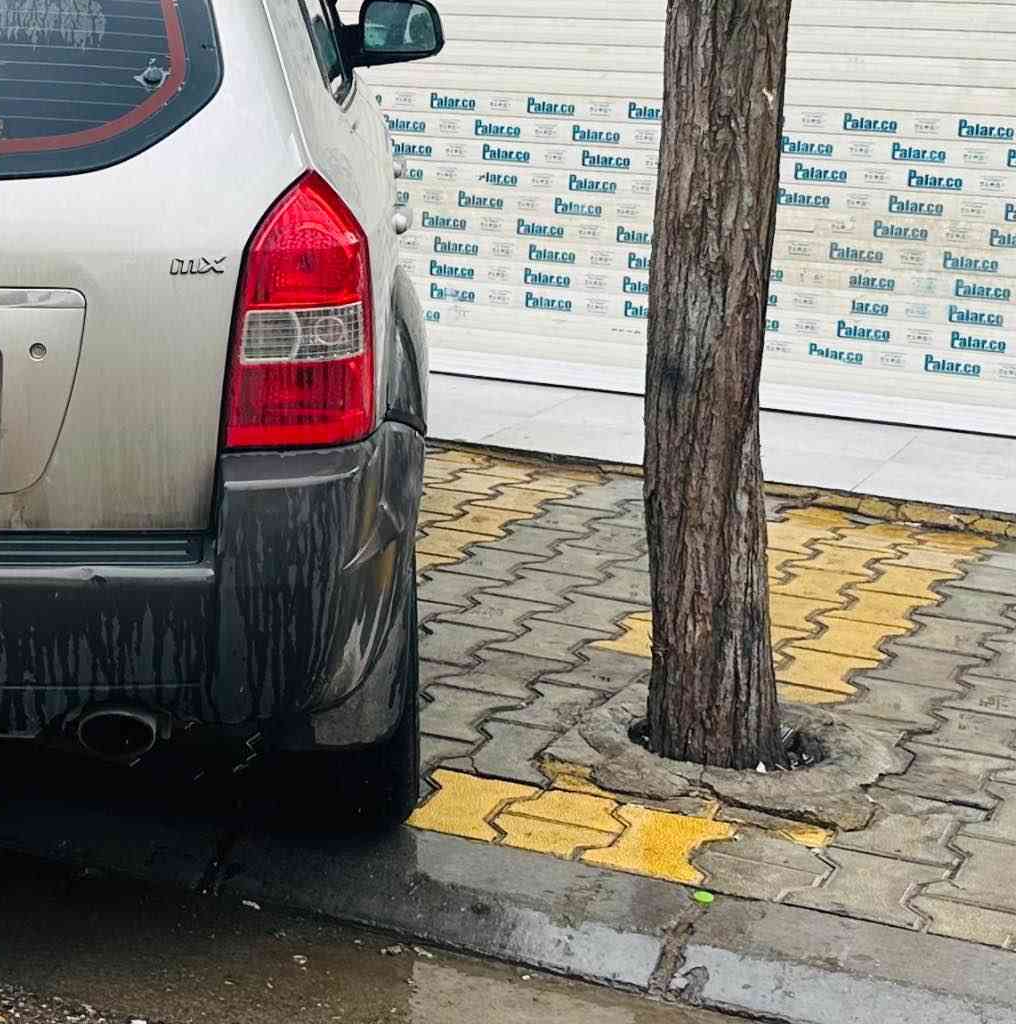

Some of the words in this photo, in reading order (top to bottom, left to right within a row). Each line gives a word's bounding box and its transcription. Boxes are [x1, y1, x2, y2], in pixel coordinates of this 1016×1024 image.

[527, 97, 574, 115] Palar.co
[475, 120, 520, 138] Palar.co
[958, 119, 1016, 140] Palar.co
[582, 151, 630, 168] Palar.co
[892, 143, 946, 163] Palar.co
[794, 163, 847, 183] Palar.co
[569, 175, 616, 192] Palar.co
[554, 198, 601, 215] Palar.co
[888, 196, 942, 213] Palar.co
[873, 220, 928, 240] Palar.co
[434, 237, 478, 255] Palar.co
[529, 245, 575, 263] Palar.co
[829, 242, 884, 263] Palar.co
[430, 260, 473, 279] Palar.co
[524, 268, 569, 288] Palar.co
[954, 280, 1009, 300] Palar.co
[525, 292, 571, 311] Palar.co
[948, 305, 1000, 327] Palar.co
[837, 320, 889, 342] Palar.co
[951, 331, 1006, 353] Palar.co
[809, 343, 863, 364] Palar.co
[924, 354, 980, 376] Palar.co
